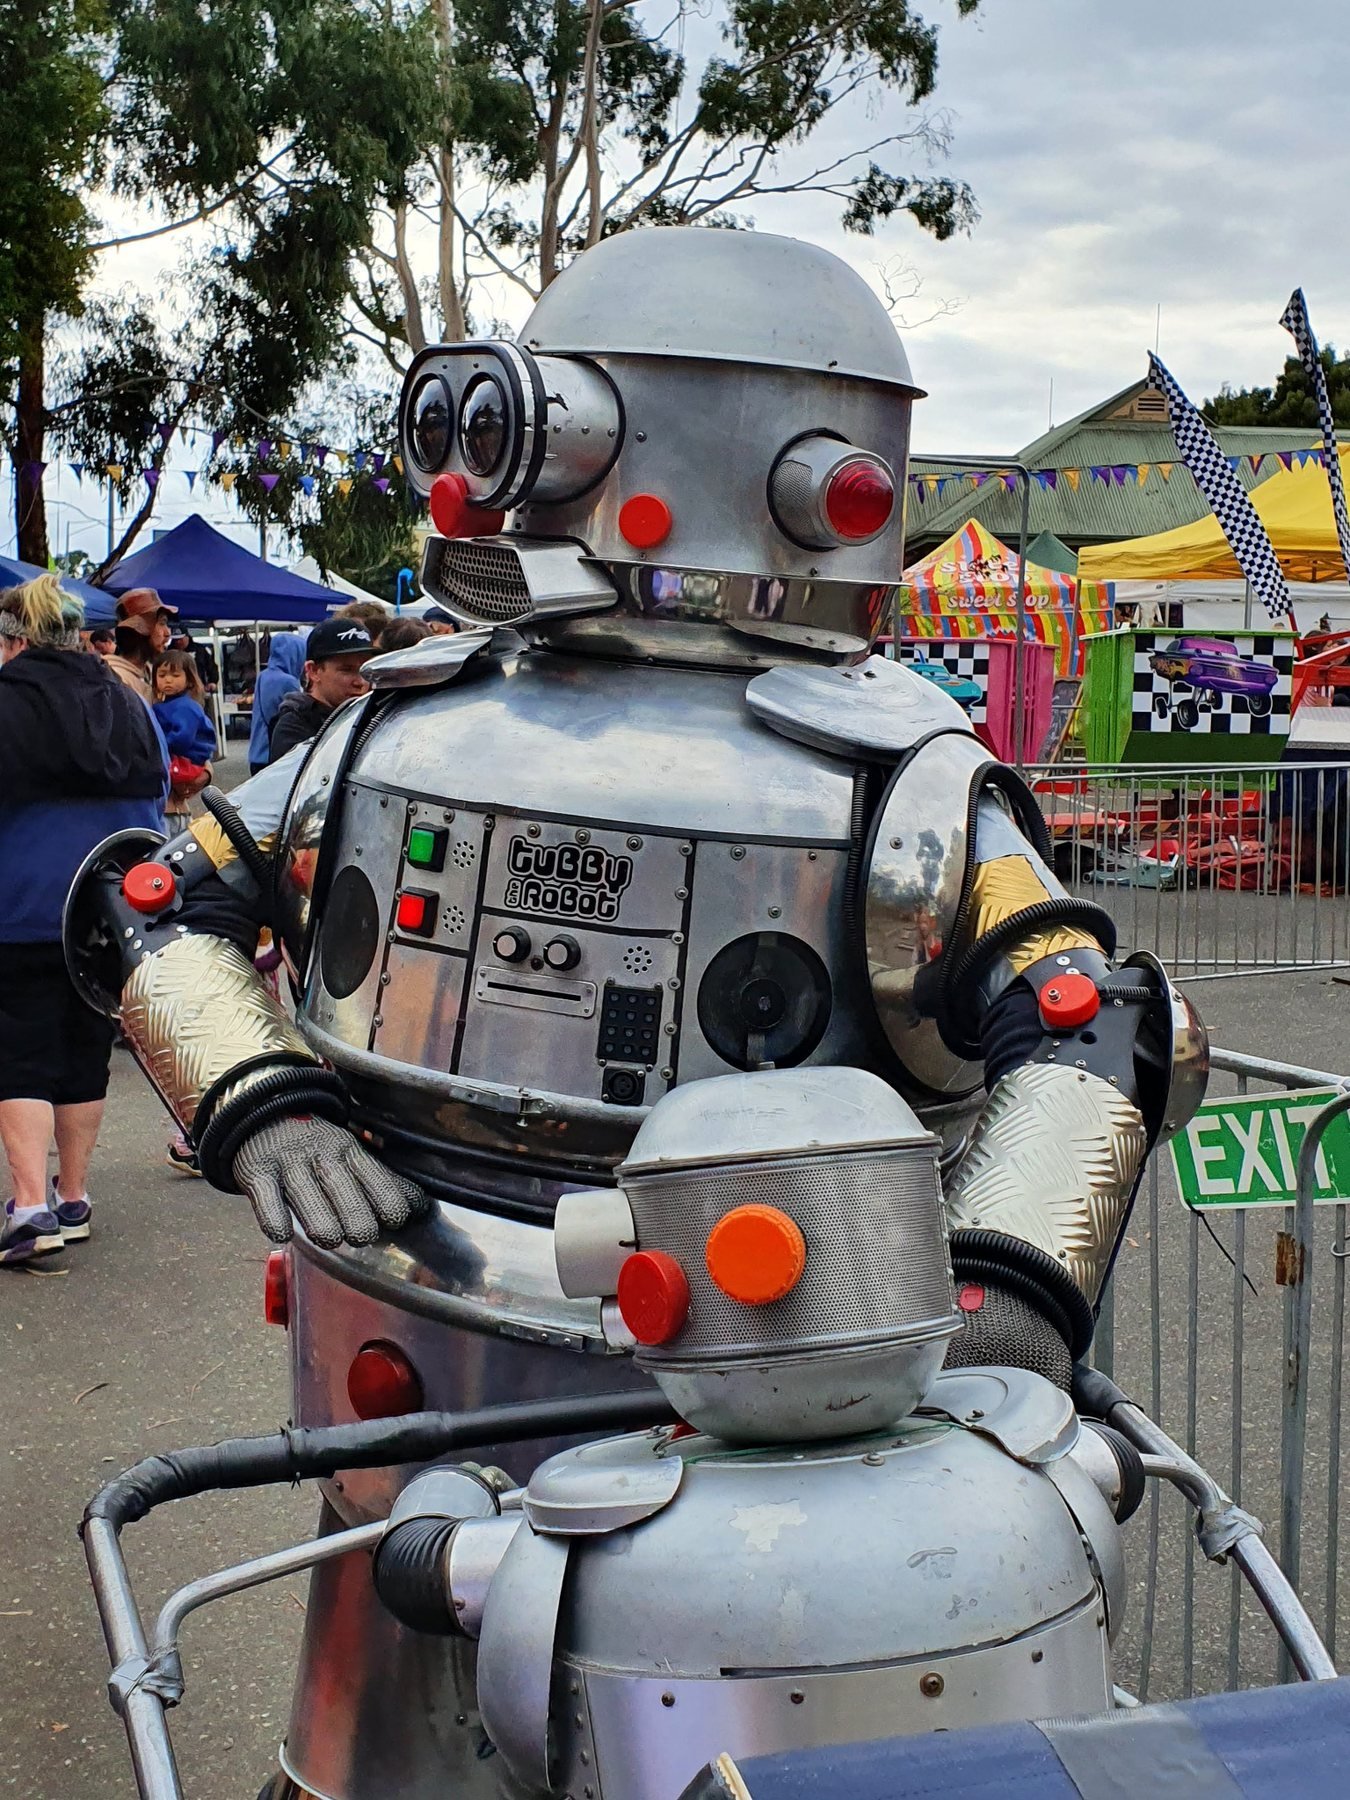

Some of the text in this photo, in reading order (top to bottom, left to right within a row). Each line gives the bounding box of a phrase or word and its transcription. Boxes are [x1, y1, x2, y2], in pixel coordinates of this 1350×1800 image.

[947, 592, 1002, 608] sweet
[1006, 591, 1050, 609] sop
[1186, 1104, 1332, 1195] EXIT
